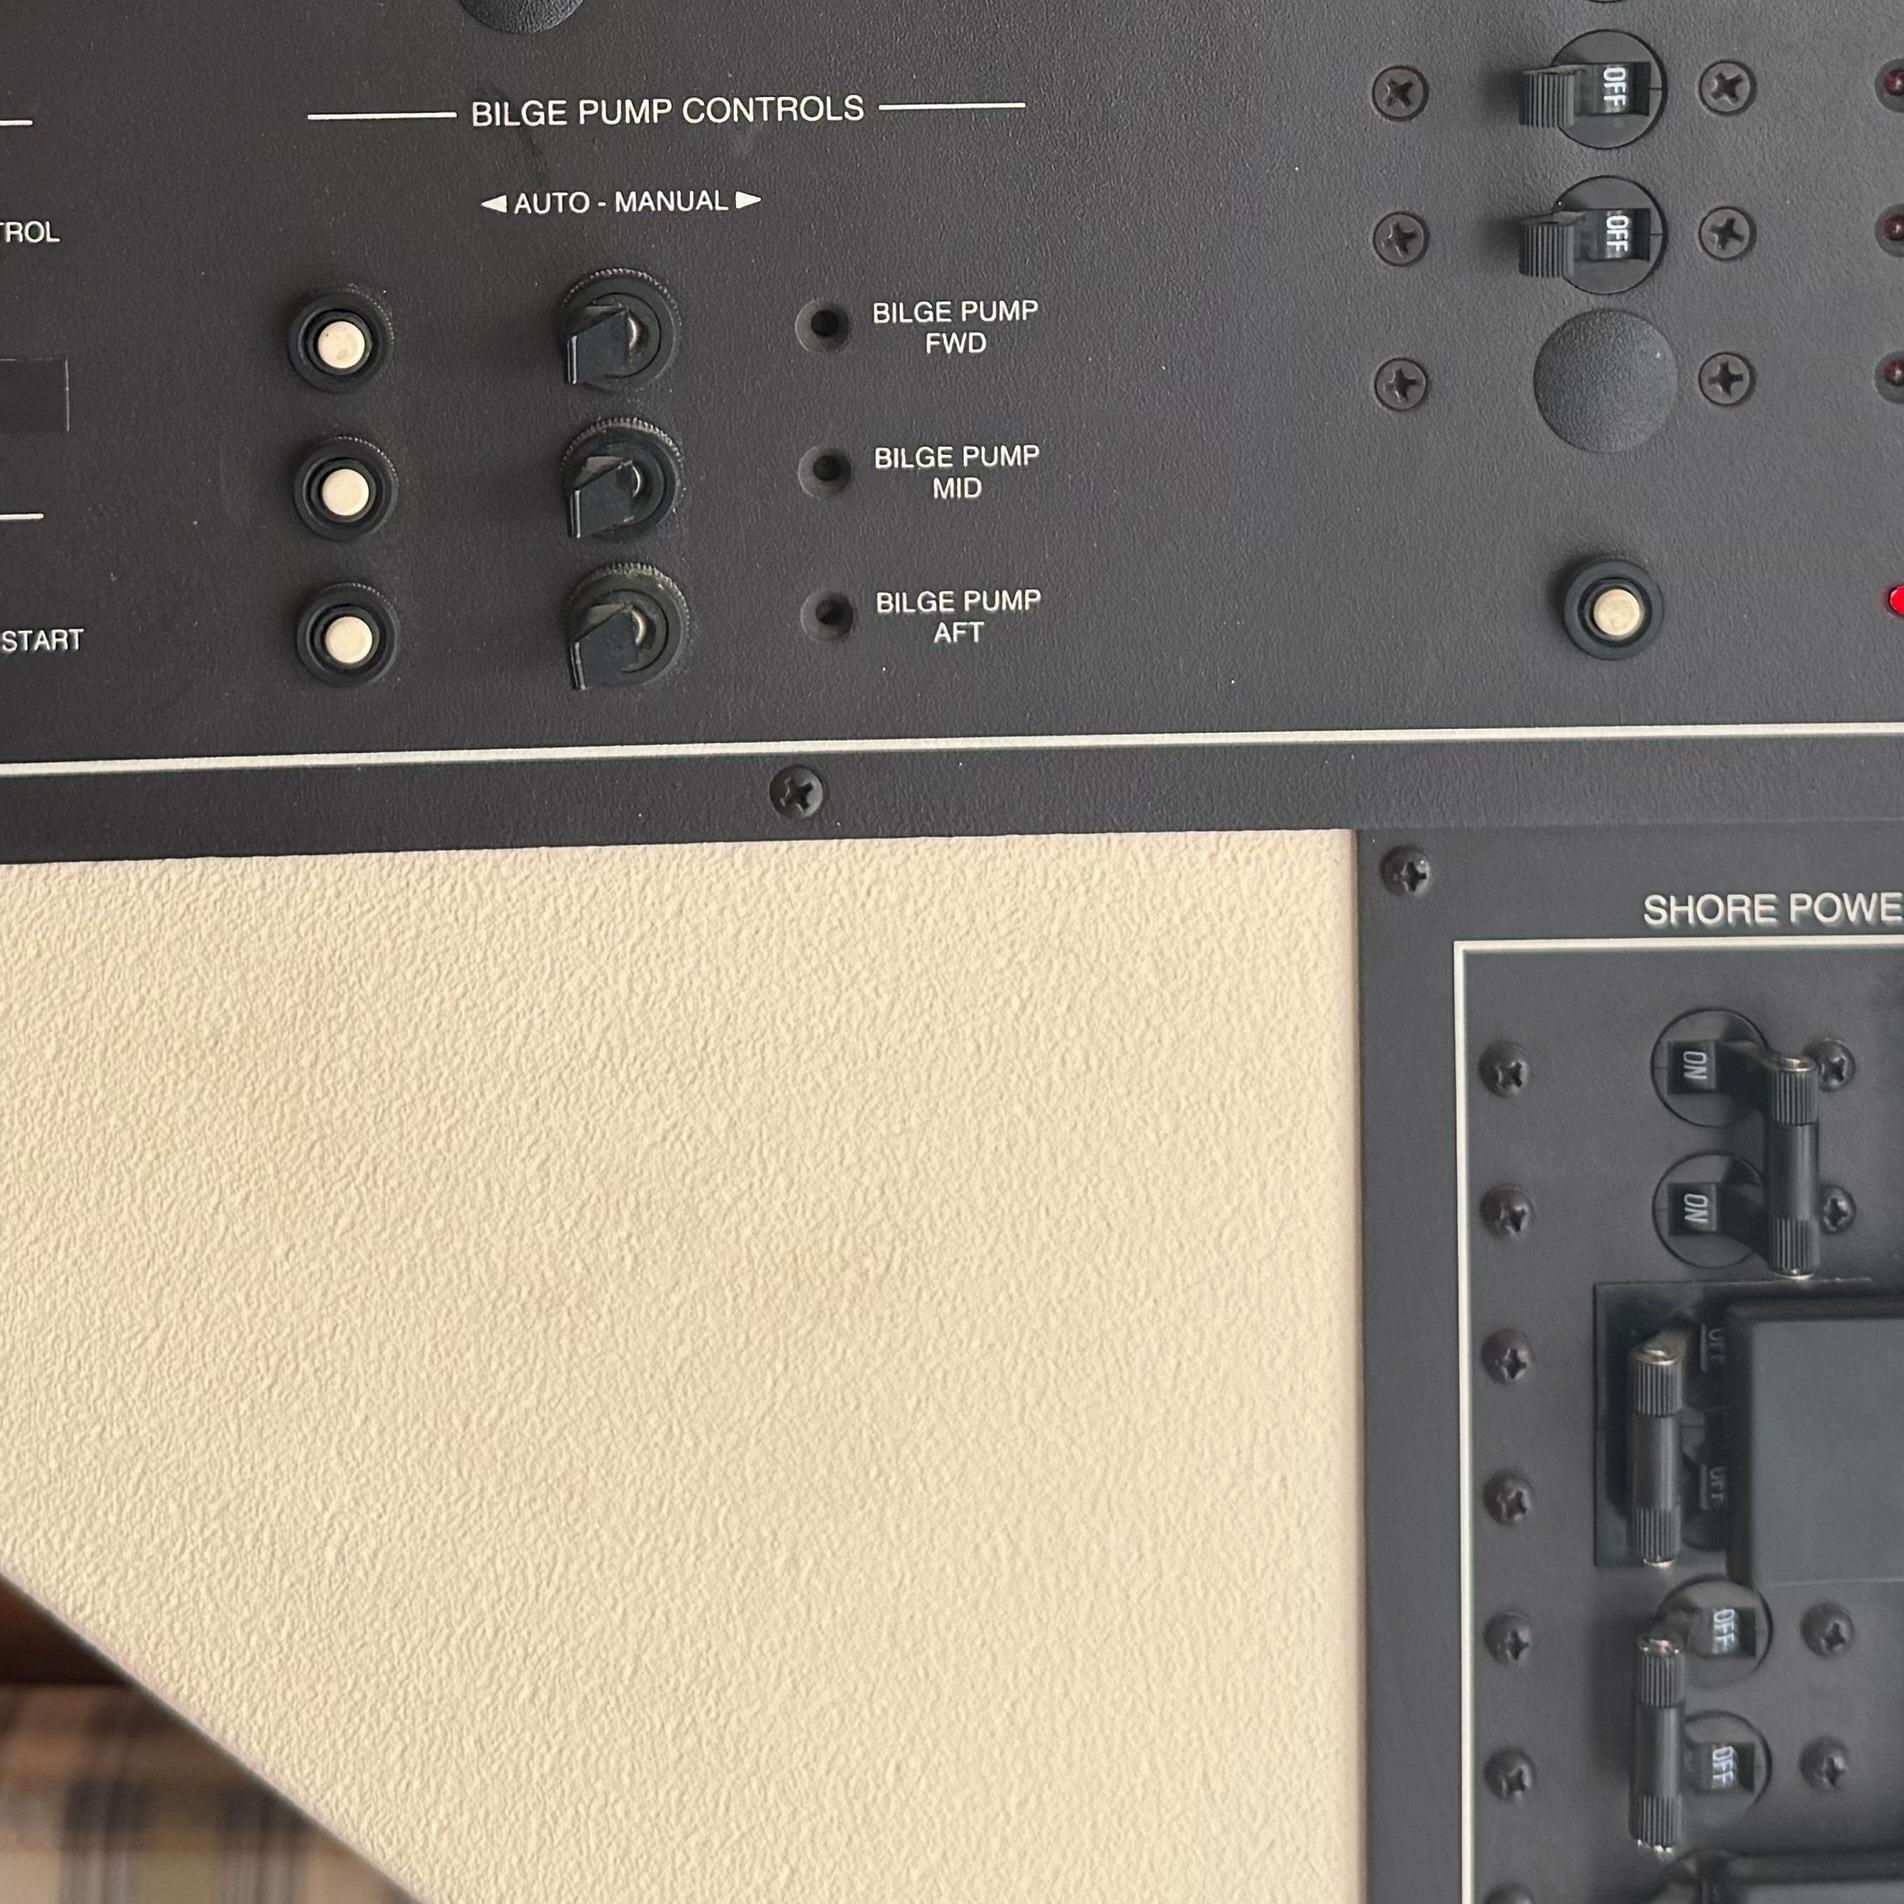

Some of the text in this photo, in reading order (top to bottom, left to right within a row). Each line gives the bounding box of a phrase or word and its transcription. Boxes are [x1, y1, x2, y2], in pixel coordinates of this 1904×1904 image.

[472, 94, 865, 127] BILGE PUMP CONTROLS
[513, 191, 590, 215] AUTO
[615, 189, 730, 213] MANUAL
[873, 299, 1039, 324] BILGE PUMP
[926, 331, 987, 354] FWD
[876, 589, 1042, 614] BILGE PUMP
[1, 628, 84, 653] START
[933, 621, 985, 644] AFT
[1644, 893, 1777, 926] SHORE
[1682, 1049, 1708, 1082] ON
